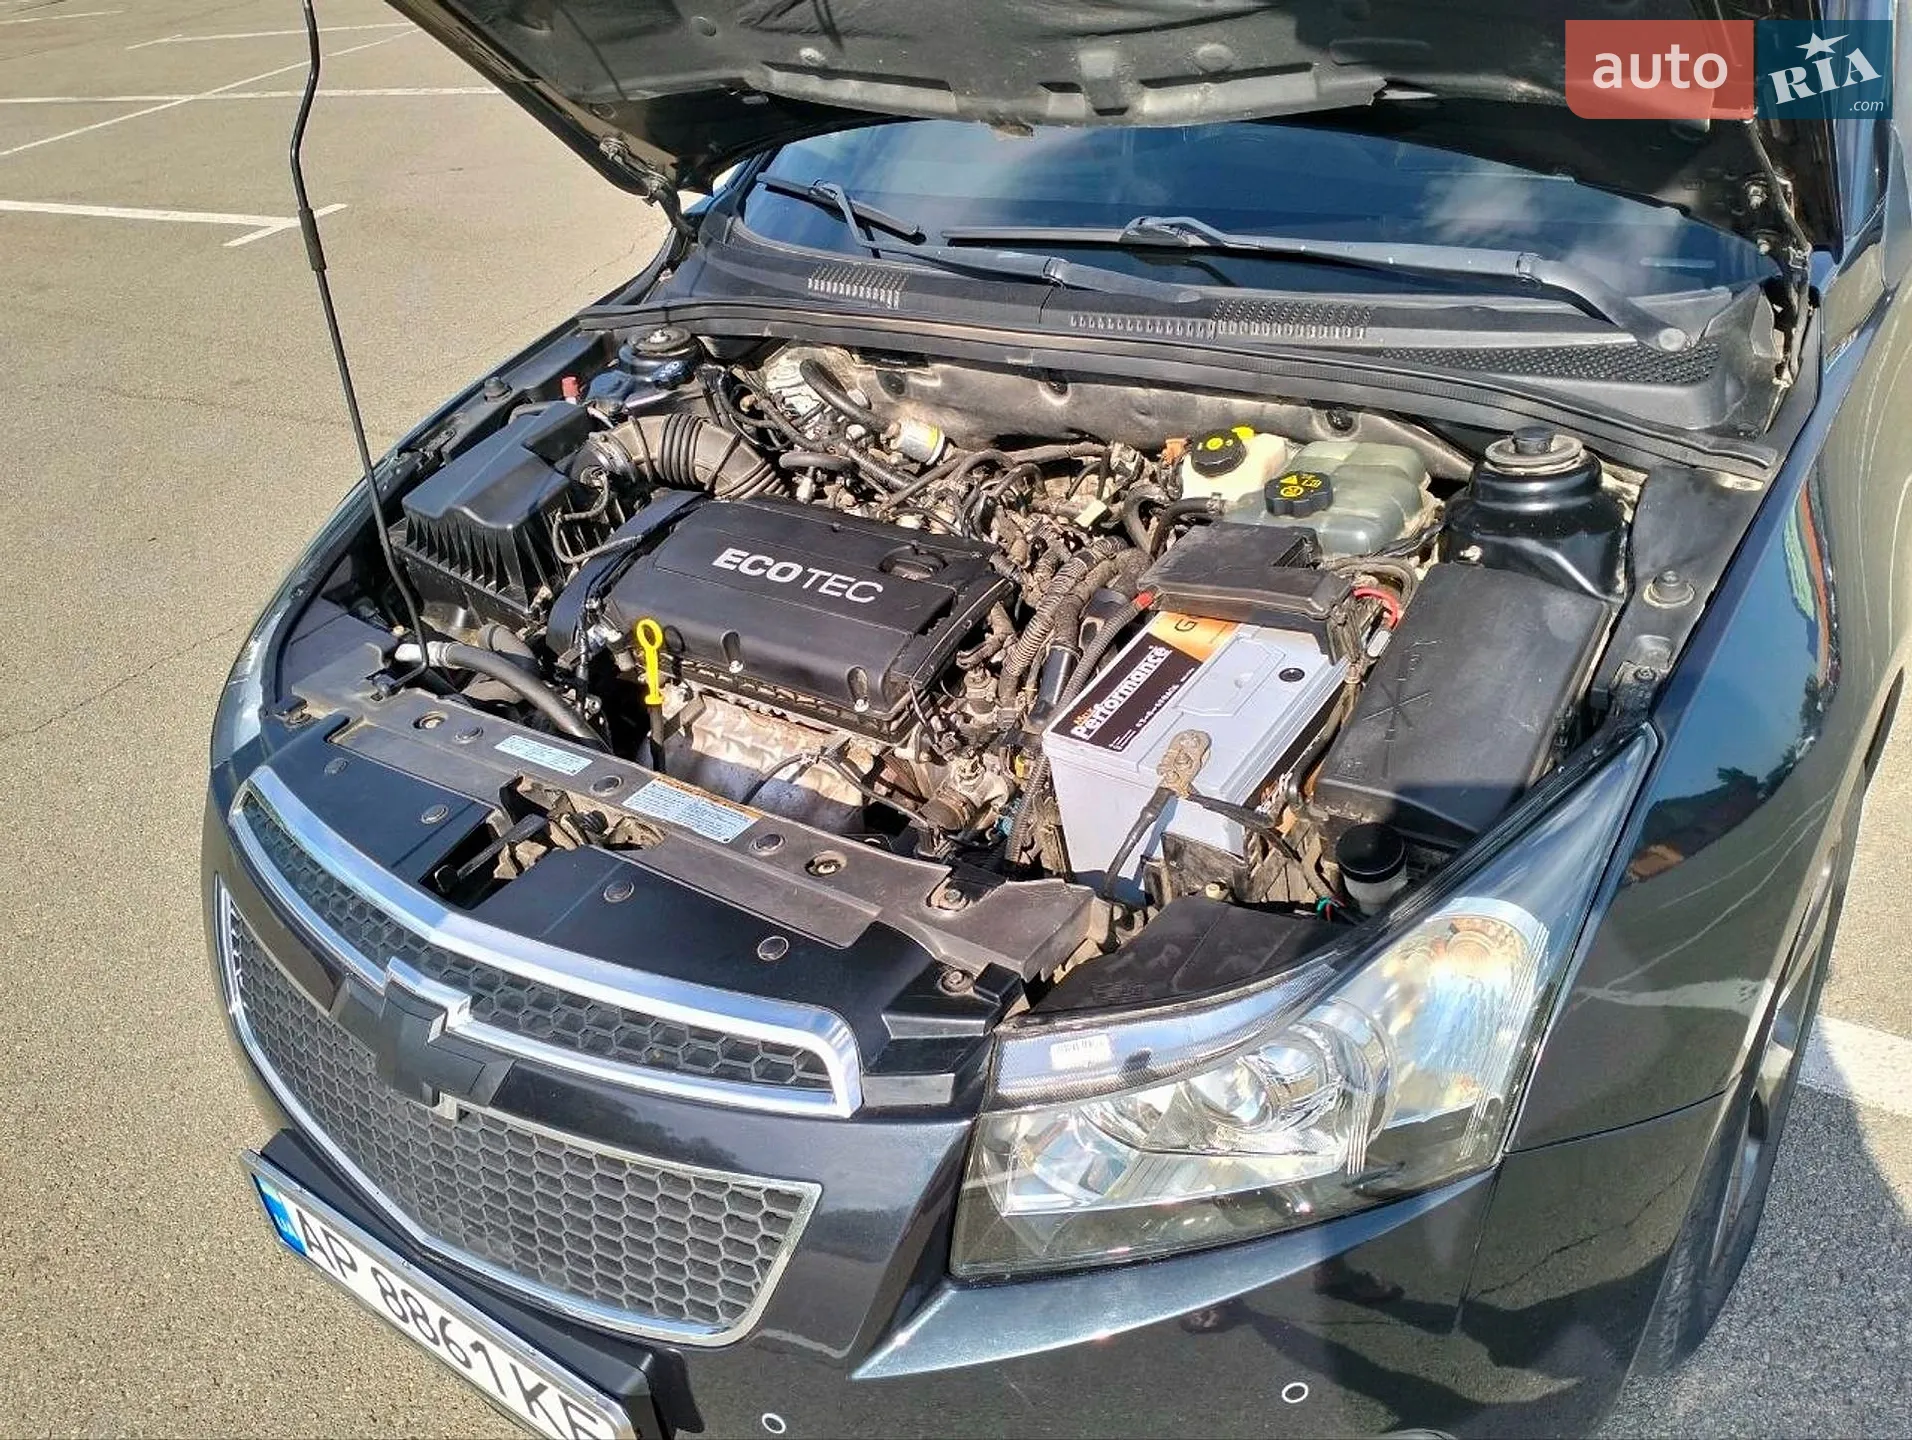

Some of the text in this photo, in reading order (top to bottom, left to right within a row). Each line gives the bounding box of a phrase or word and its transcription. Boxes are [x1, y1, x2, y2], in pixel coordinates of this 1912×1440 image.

[712, 547, 884, 603] ECOTEC
[1070, 646, 1172, 740] Performance
[296, 1208, 358, 1279] AP
[371, 1266, 507, 1397] 8861
